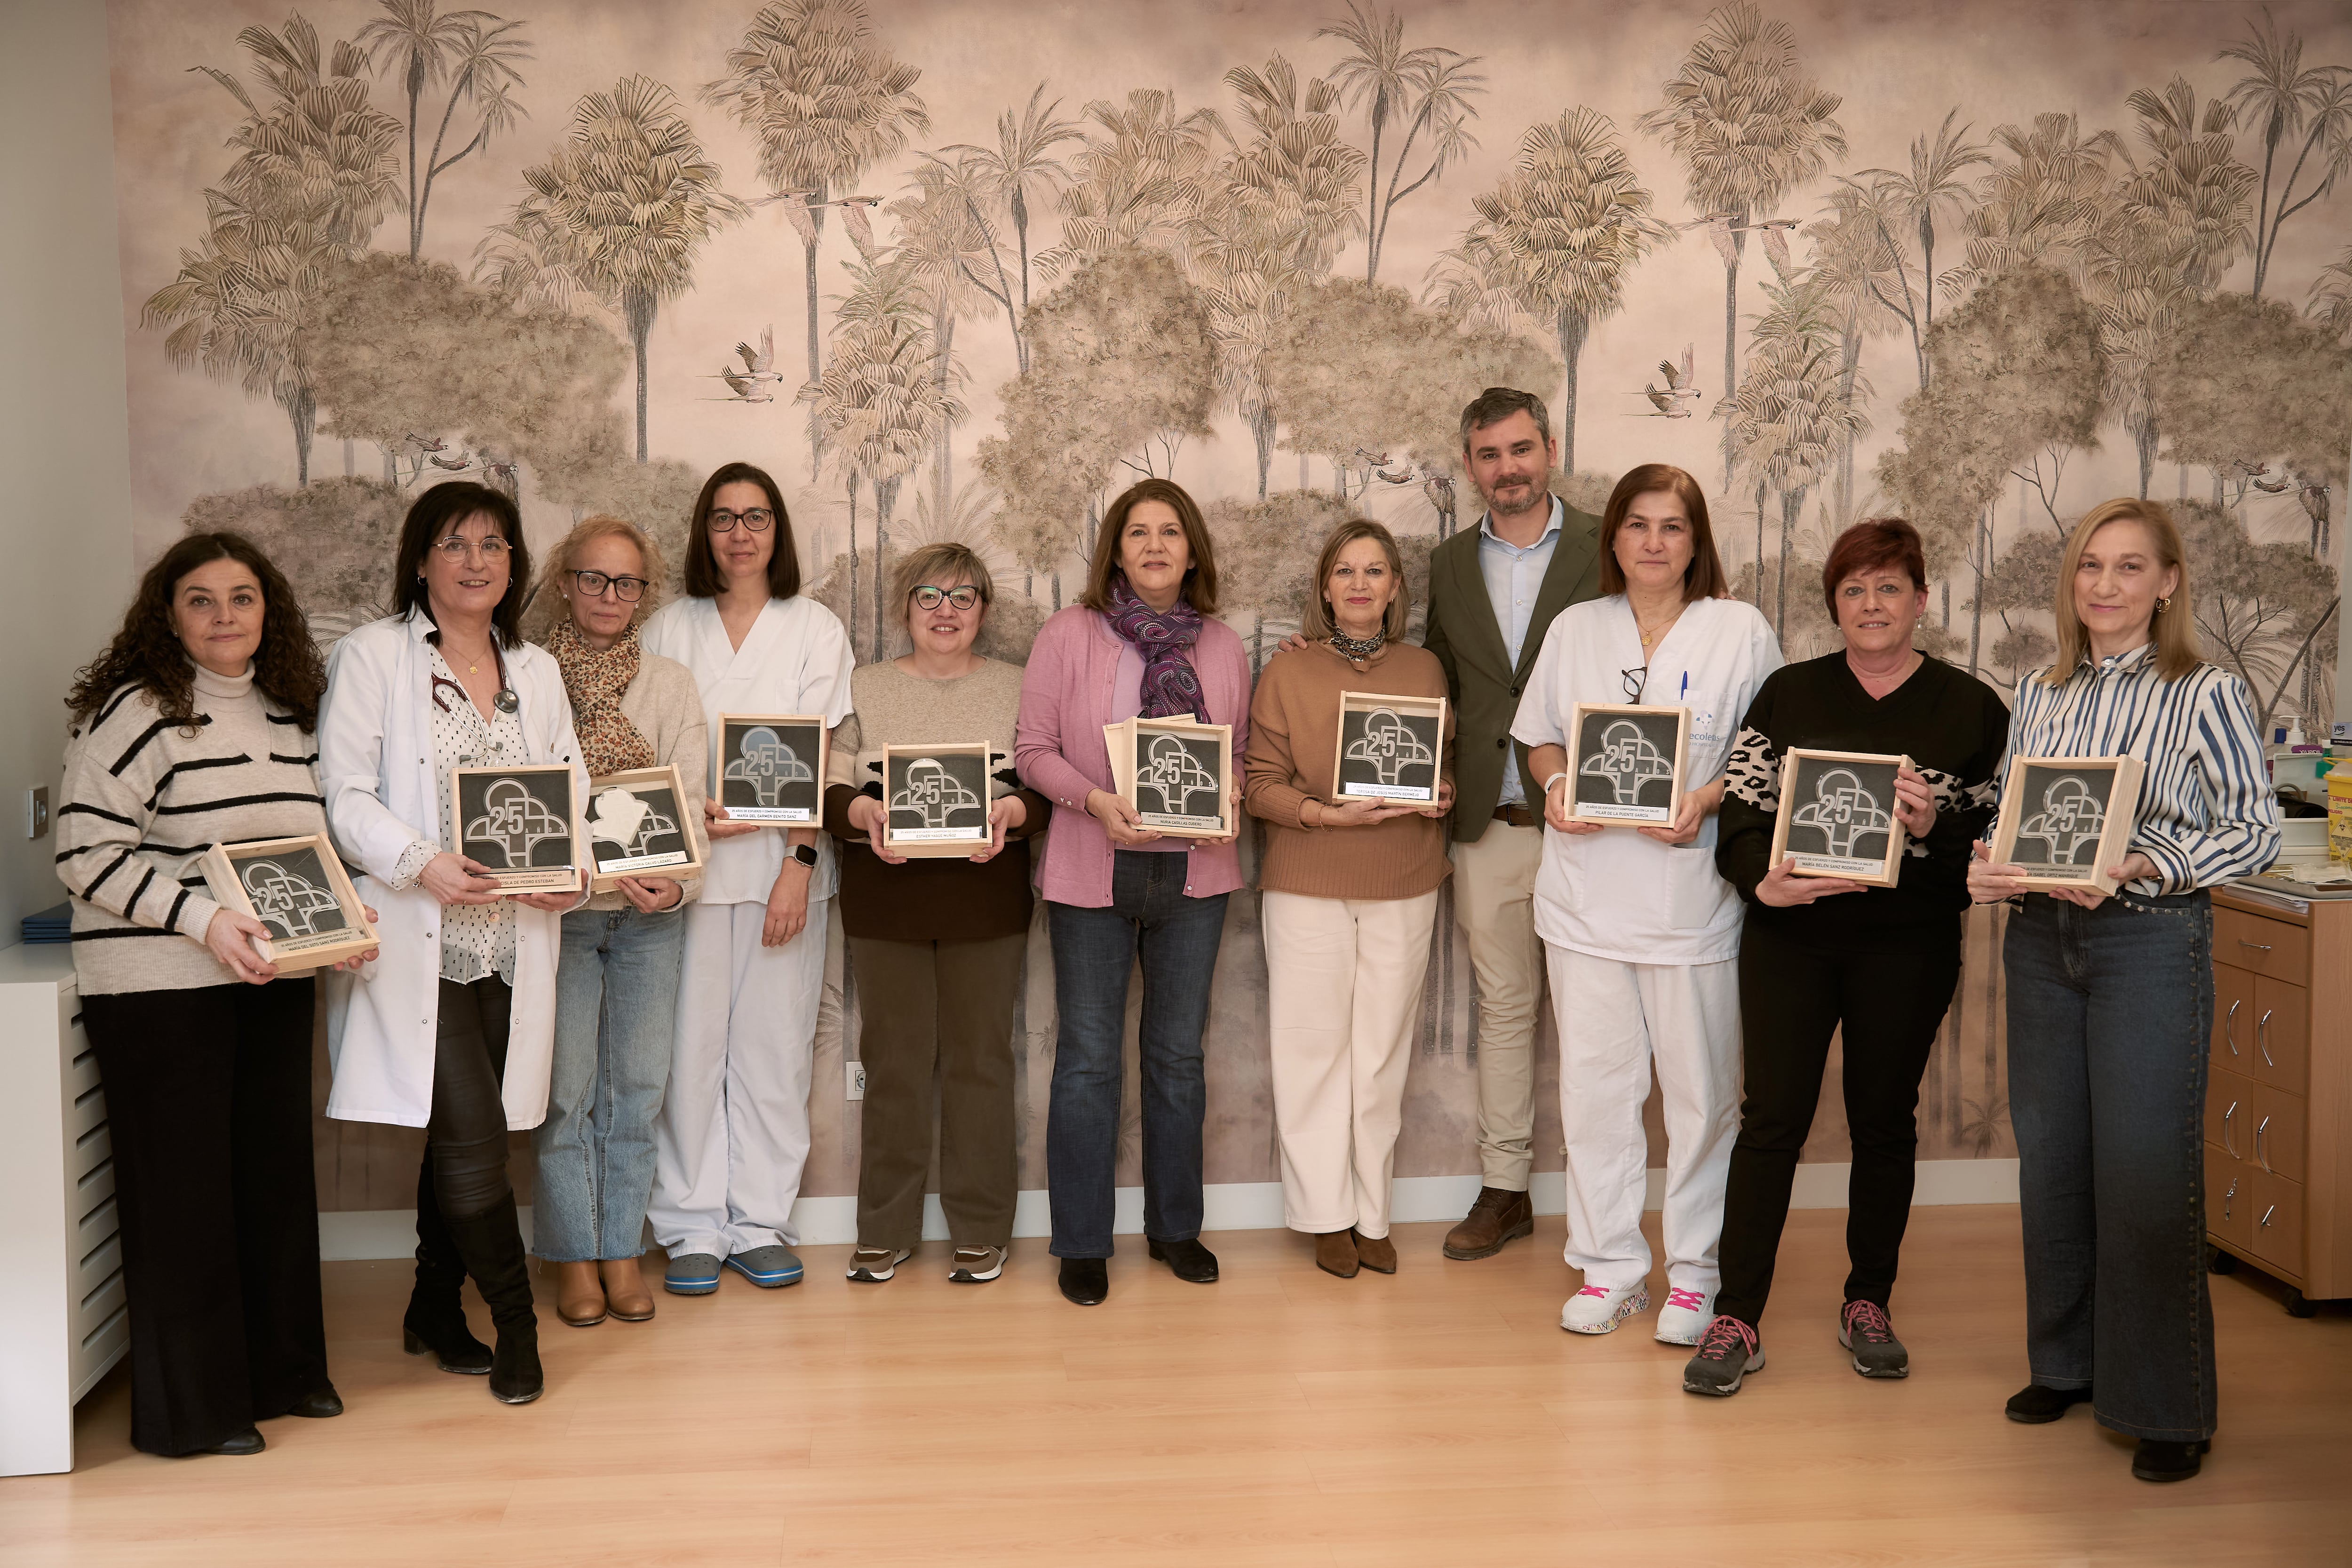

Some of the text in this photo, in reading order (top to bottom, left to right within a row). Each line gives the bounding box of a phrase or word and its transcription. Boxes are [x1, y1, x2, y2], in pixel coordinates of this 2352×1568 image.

[1367, 732, 1395, 757] 25
[745, 750, 774, 776] 25
[1153, 757, 1180, 784] 25
[1604, 745, 1635, 772] 25
[911, 781, 940, 804] 25
[490, 806, 524, 835] 25
[1818, 794, 1852, 824] 25
[2043, 804, 2077, 832] 25
[1851, 819, 1888, 828] AÑOS
[255, 884, 294, 913] 25
[296, 899, 330, 908] AÑOS
